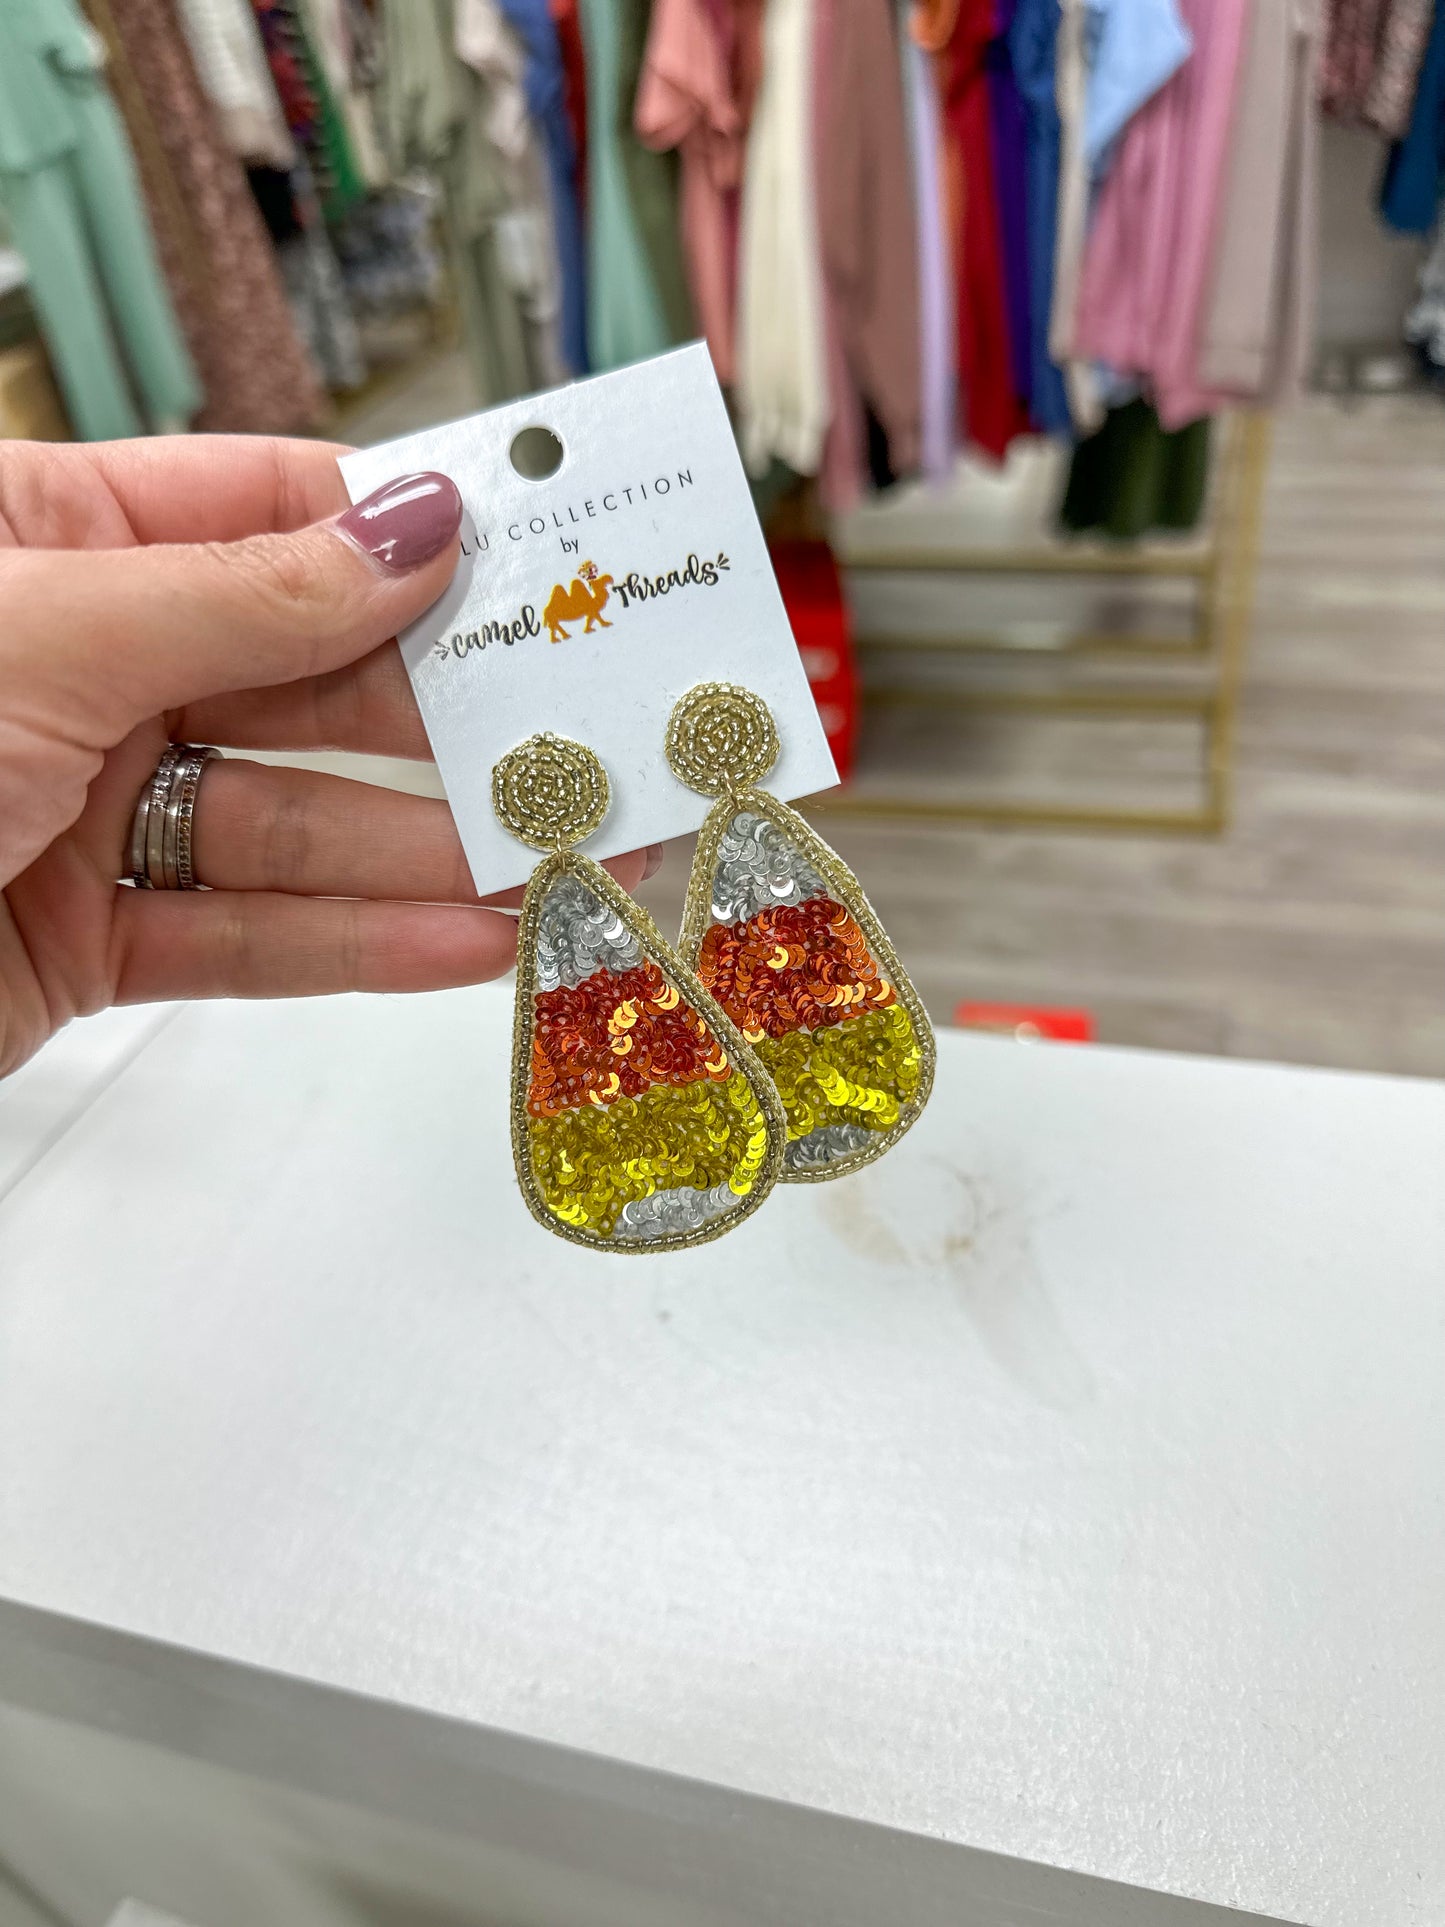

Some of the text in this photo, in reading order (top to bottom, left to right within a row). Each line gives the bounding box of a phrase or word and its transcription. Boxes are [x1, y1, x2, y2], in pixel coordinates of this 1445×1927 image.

[460, 469, 694, 556] LU COLLECTION
[560, 537, 579, 554] by
[612, 553, 719, 608] Threads
